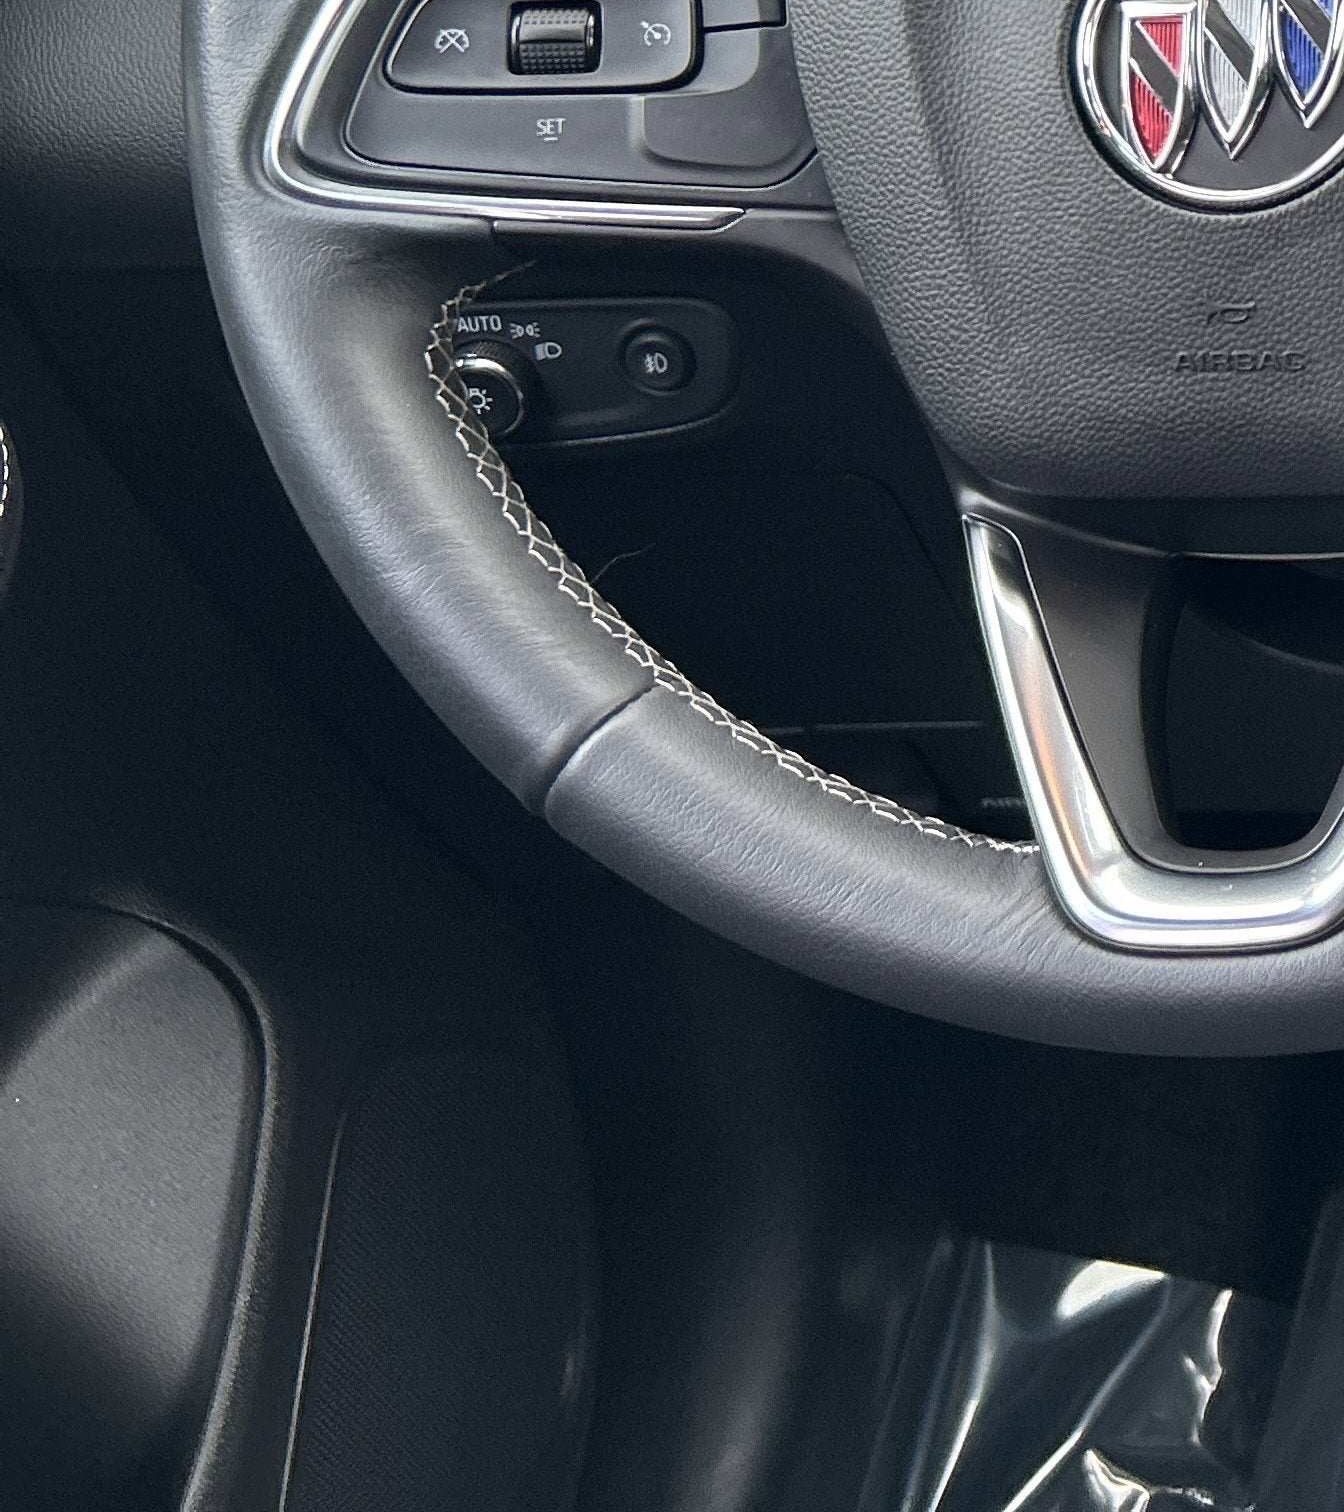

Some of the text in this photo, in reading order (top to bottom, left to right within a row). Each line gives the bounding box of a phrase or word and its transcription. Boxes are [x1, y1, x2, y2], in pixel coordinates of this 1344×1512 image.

[536, 118, 566, 136] SET
[457, 315, 502, 333] AUTO
[1175, 350, 1306, 373] AIRBAG
